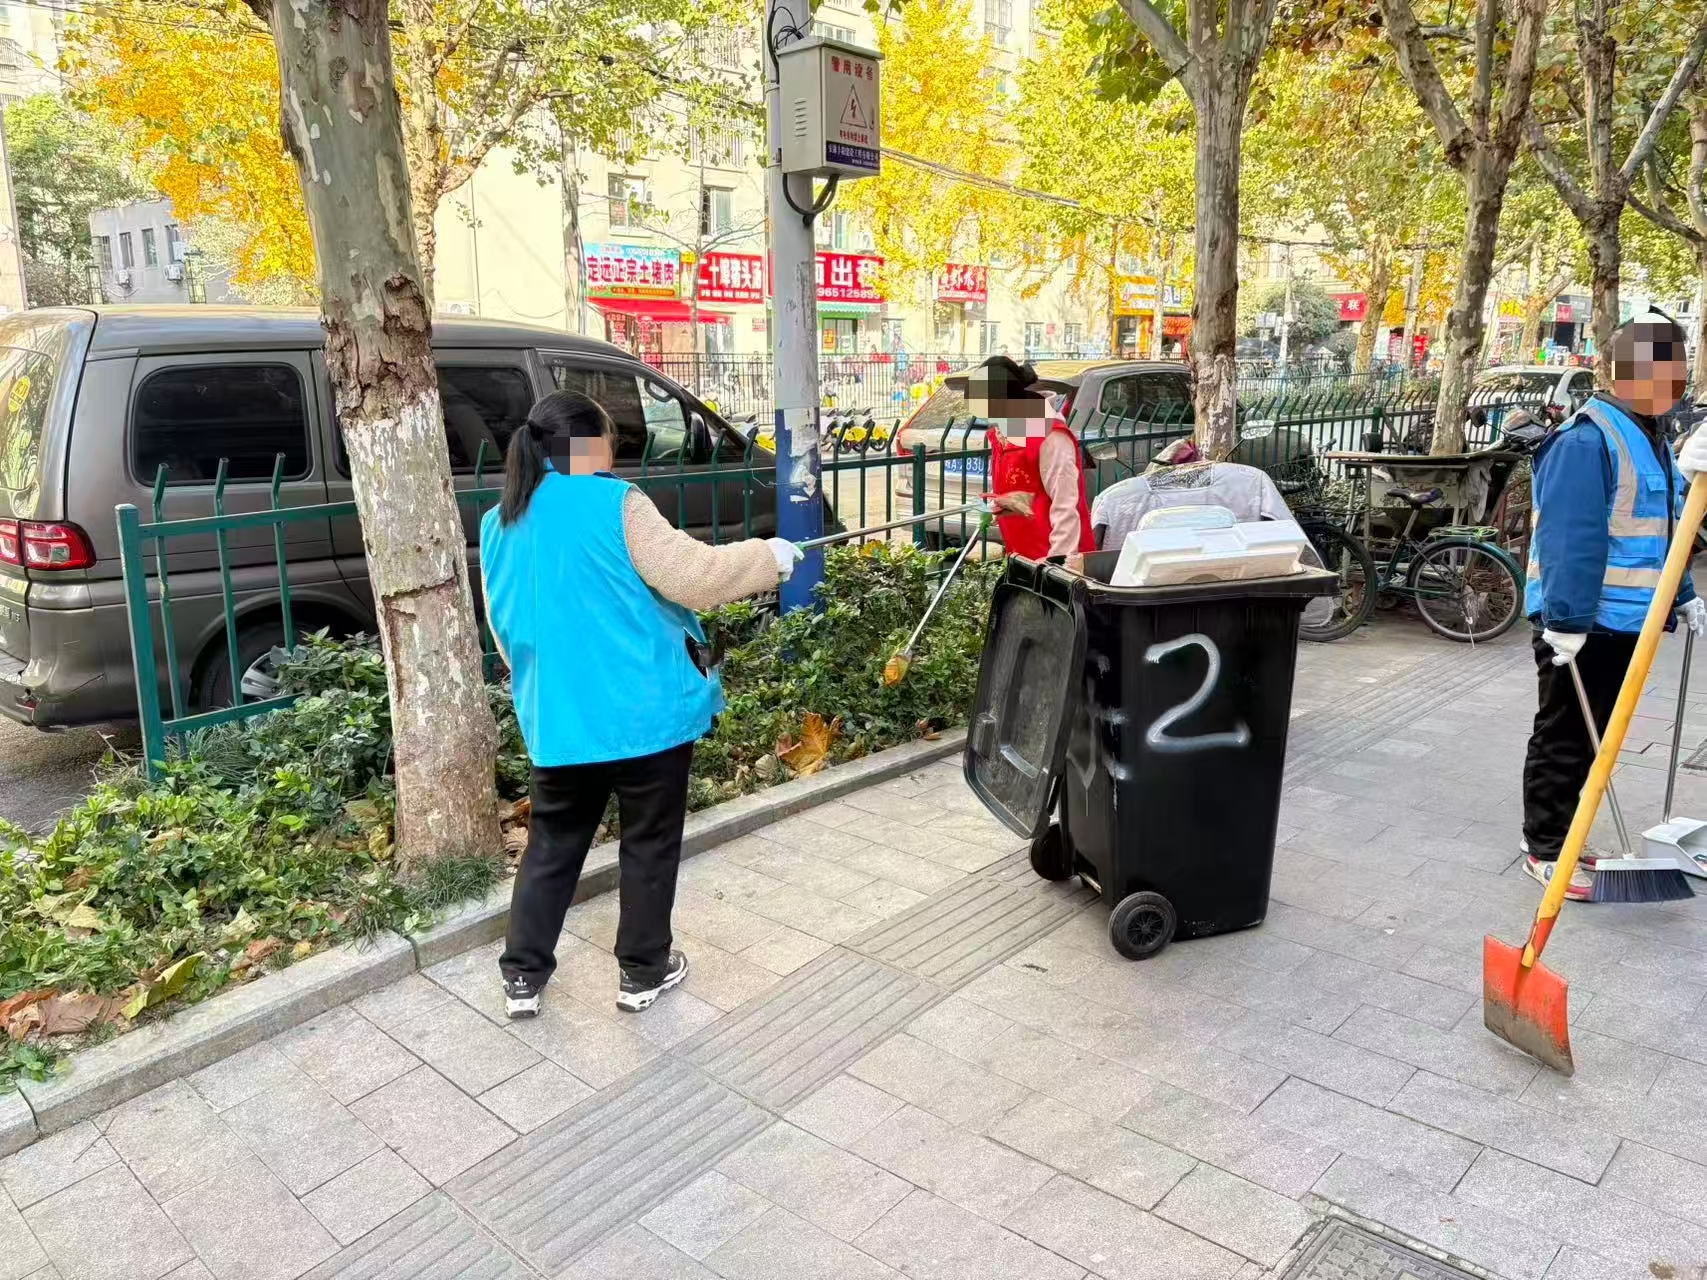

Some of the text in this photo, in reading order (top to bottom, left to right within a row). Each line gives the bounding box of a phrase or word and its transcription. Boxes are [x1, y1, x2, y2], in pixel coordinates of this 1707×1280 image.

[587, 255, 675, 285] 定远正宗土猪肉
[1144, 633, 1251, 753] 2
